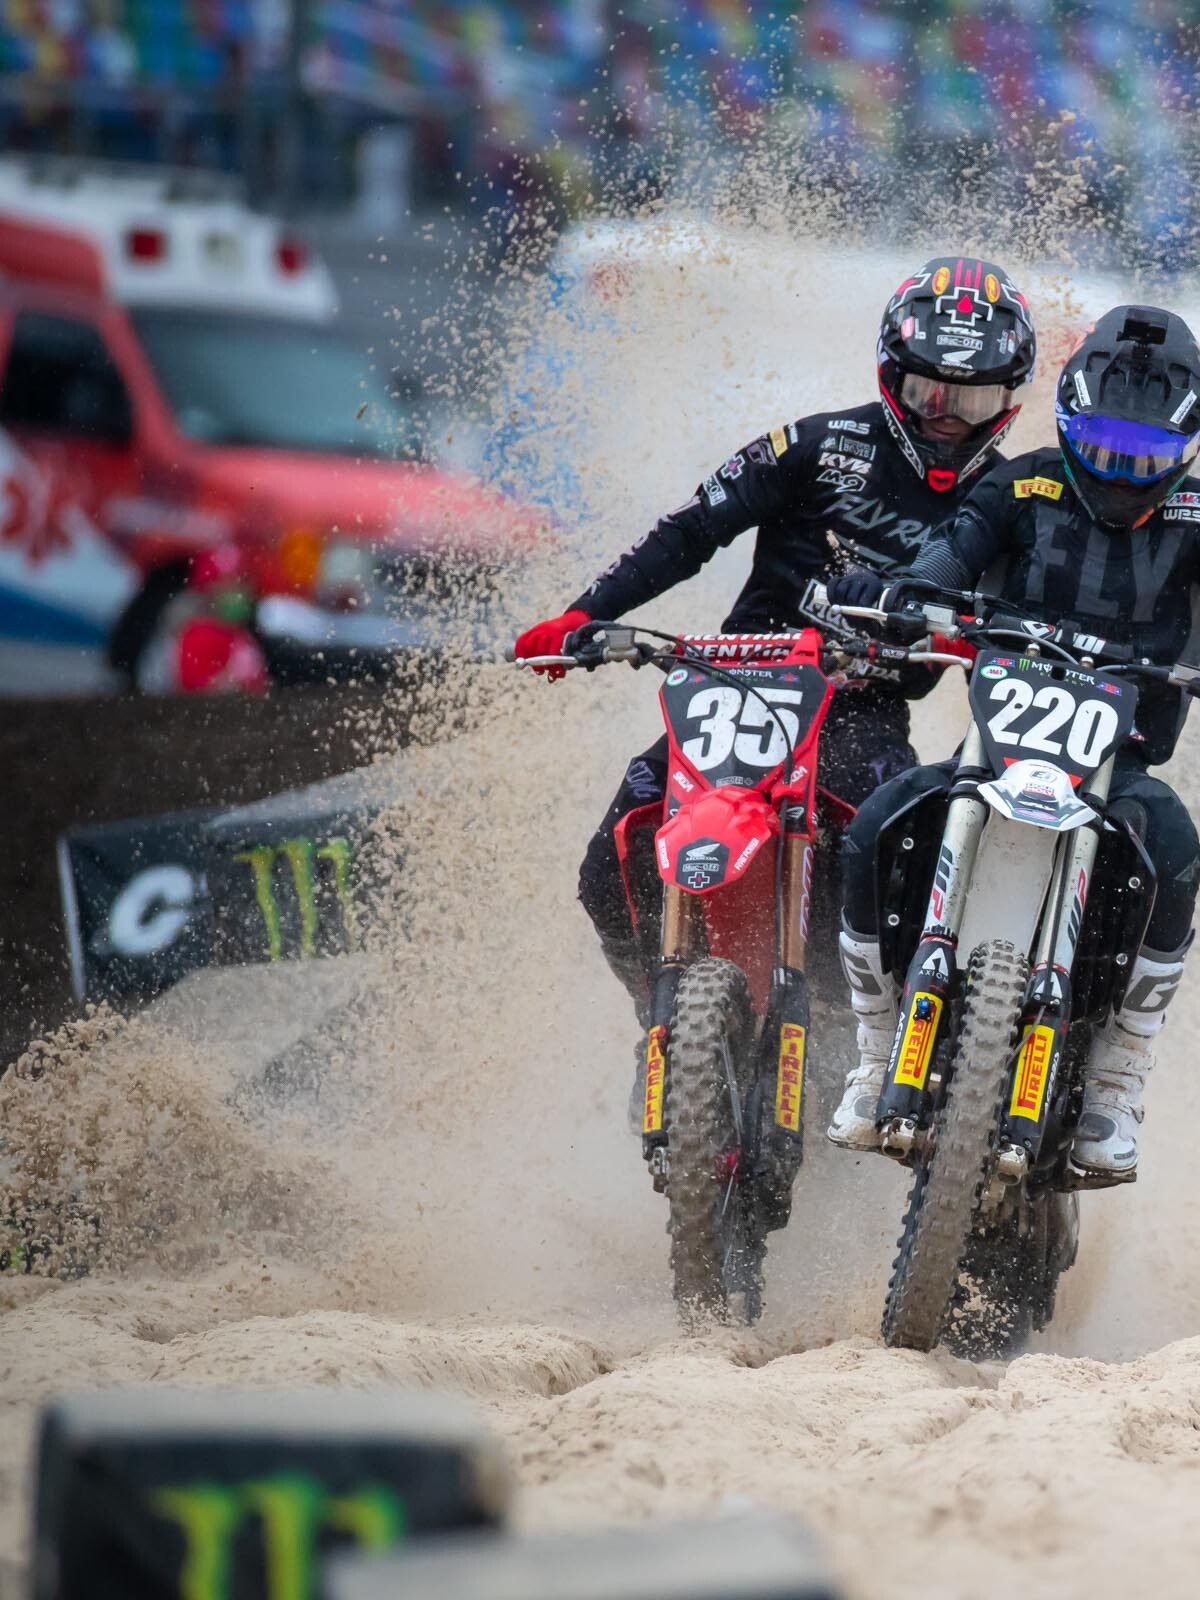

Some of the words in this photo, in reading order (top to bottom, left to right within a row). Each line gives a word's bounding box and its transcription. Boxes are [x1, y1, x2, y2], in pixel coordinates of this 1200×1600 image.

[1025, 503, 1186, 622] FLY
[682, 686, 803, 771] 35
[987, 678, 1119, 768] 220
[780, 1028, 803, 1126] PIRELLI
[901, 998, 937, 1079] RELLI
[1017, 1032, 1047, 1110] PIRELLI
